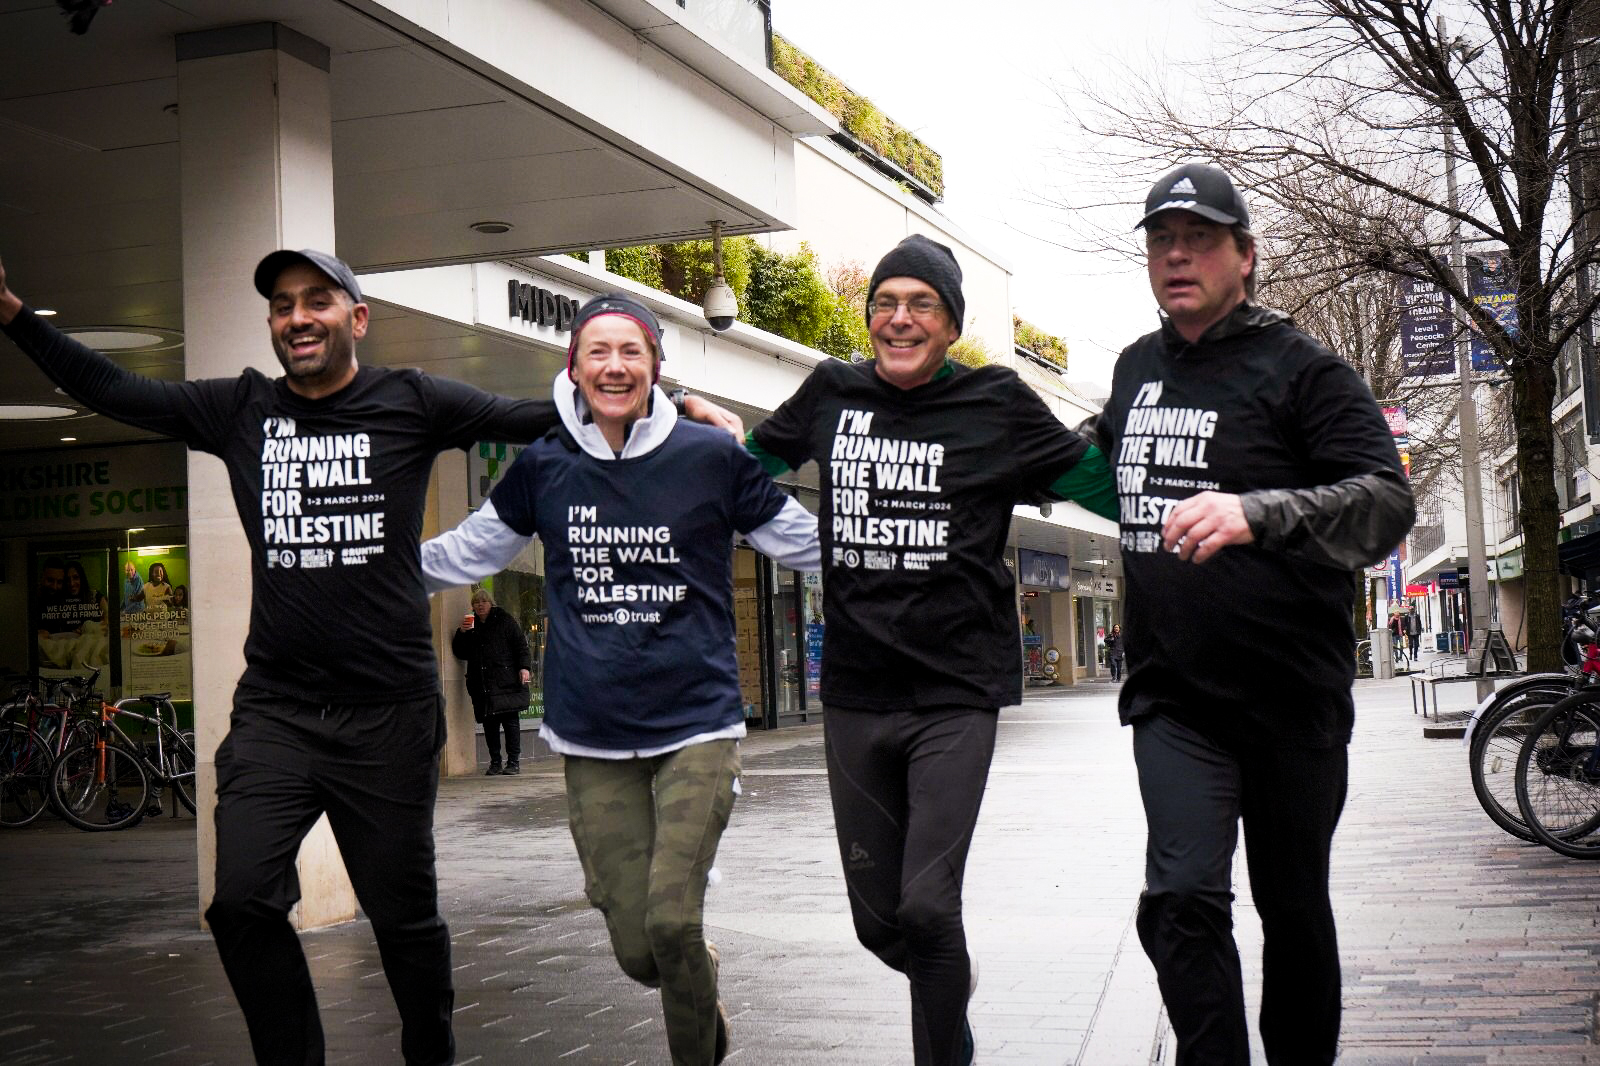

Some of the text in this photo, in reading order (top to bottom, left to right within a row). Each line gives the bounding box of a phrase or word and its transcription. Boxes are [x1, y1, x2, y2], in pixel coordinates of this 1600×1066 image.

[1413, 282, 1434, 292] NEW
[263, 418, 296, 437] I'M
[836, 409, 874, 435] I'M
[1124, 407, 1218, 438] RUNNING
[262, 434, 370, 462] RUNNING
[831, 434, 944, 466] RUNNING
[1118, 436, 1208, 469] THE WALL
[262, 459, 371, 489] THE WALL
[830, 461, 941, 492] THE WALL
[1116, 466, 1147, 494] FOR
[1164, 478, 1195, 488] MARCH
[1196, 480, 1220, 490] 2024
[262, 490, 302, 516] FOR
[324, 495, 358, 505] MARCH
[362, 494, 385, 502] 2024
[832, 488, 869, 516] FOR
[891, 500, 926, 510] MARCH
[568, 506, 597, 523] I'M
[264, 513, 385, 544] PALESTINE
[568, 526, 670, 544] RUNNING
[832, 515, 950, 546] PALESTINE
[342, 556, 368, 565] WALL
[569, 547, 680, 564] THE WALL
[904, 561, 930, 570] WALL
[573, 567, 614, 583] FOR
[578, 585, 687, 604] PALESTINE
[79, 603, 100, 611] BEING
[79, 610, 104, 618] FAMILY
[154, 611, 186, 620] PEOPLE
[631, 611, 661, 623] trust
